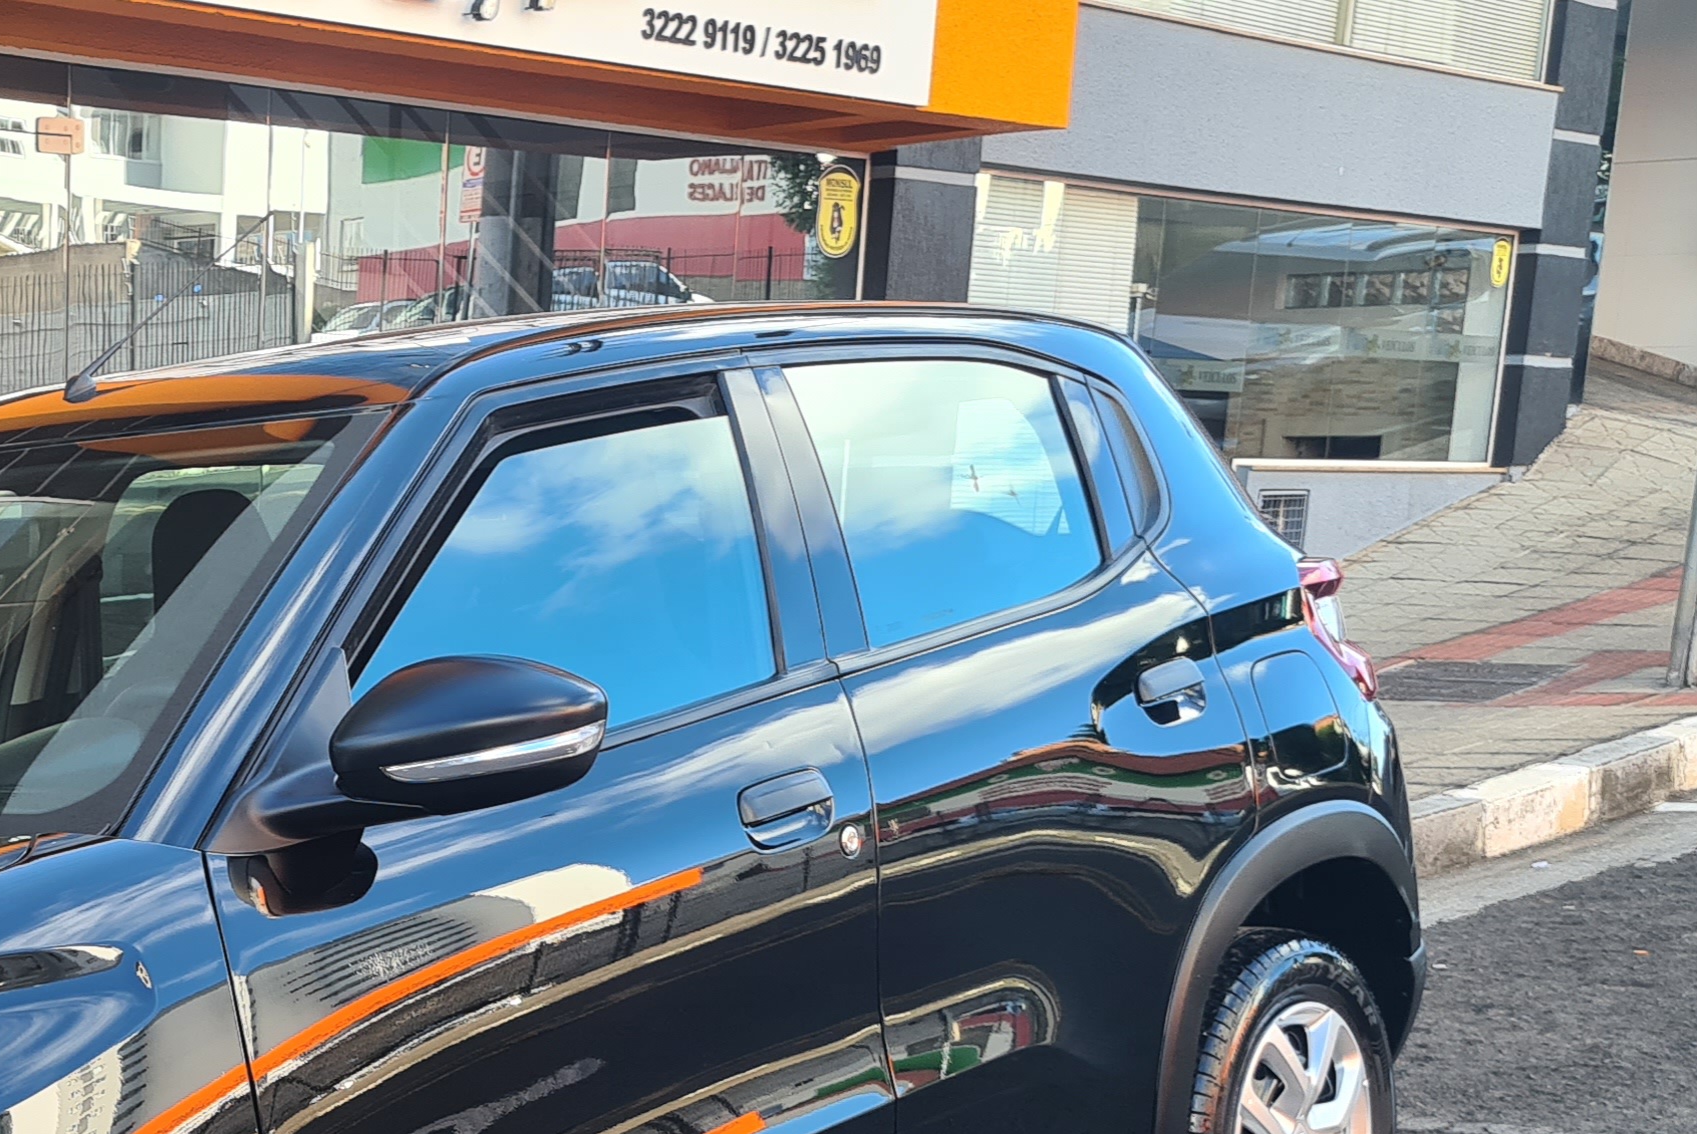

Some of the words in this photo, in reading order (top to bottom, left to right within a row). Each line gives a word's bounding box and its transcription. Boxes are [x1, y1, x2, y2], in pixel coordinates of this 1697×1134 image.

[641, 8, 697, 46] 3222
[703, 18, 755, 55] 9119
[775, 30, 827, 66] 3225
[833, 39, 881, 74] 1969
